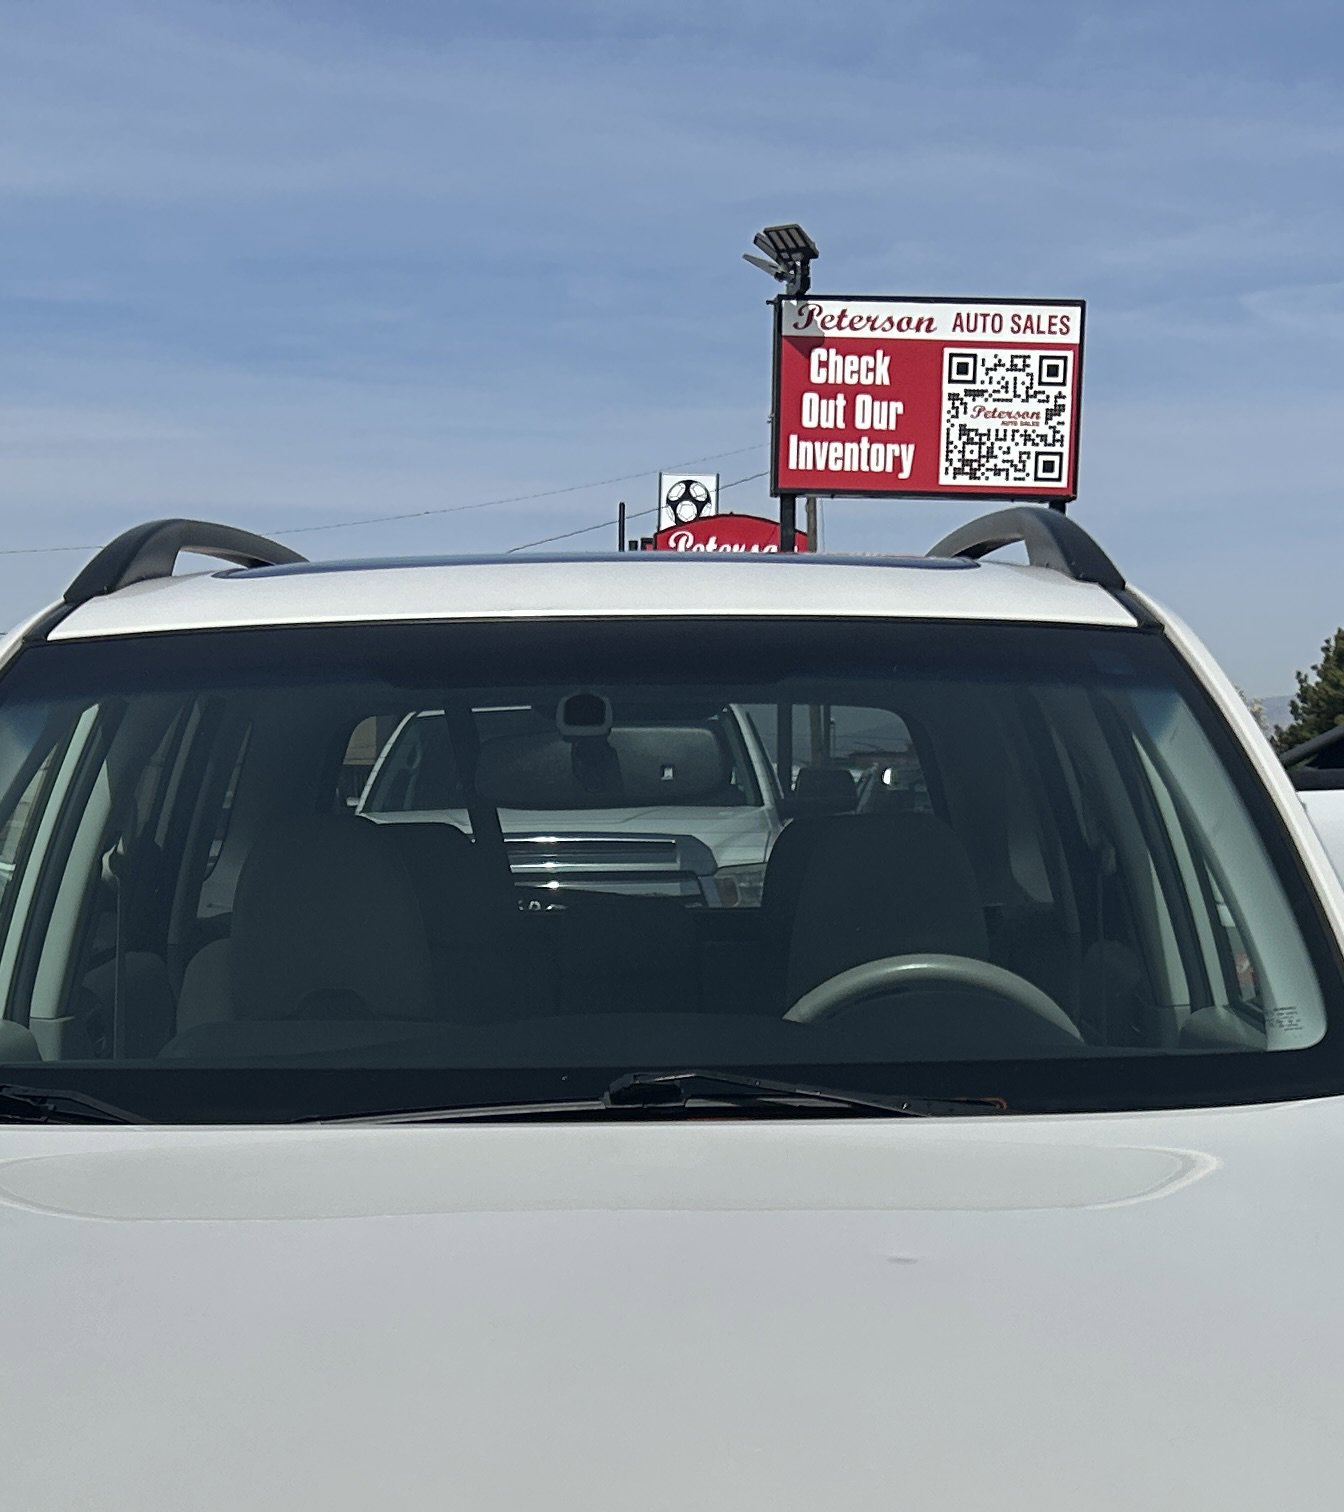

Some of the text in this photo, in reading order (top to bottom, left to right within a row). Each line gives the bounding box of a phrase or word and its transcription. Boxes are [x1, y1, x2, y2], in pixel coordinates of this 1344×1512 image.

[793, 303, 1071, 336] Peterson AUTO SALES
[810, 347, 891, 386] Check
[801, 392, 905, 431] Out Our
[970, 404, 1041, 420] Peterson
[788, 434, 916, 480] Inventory
